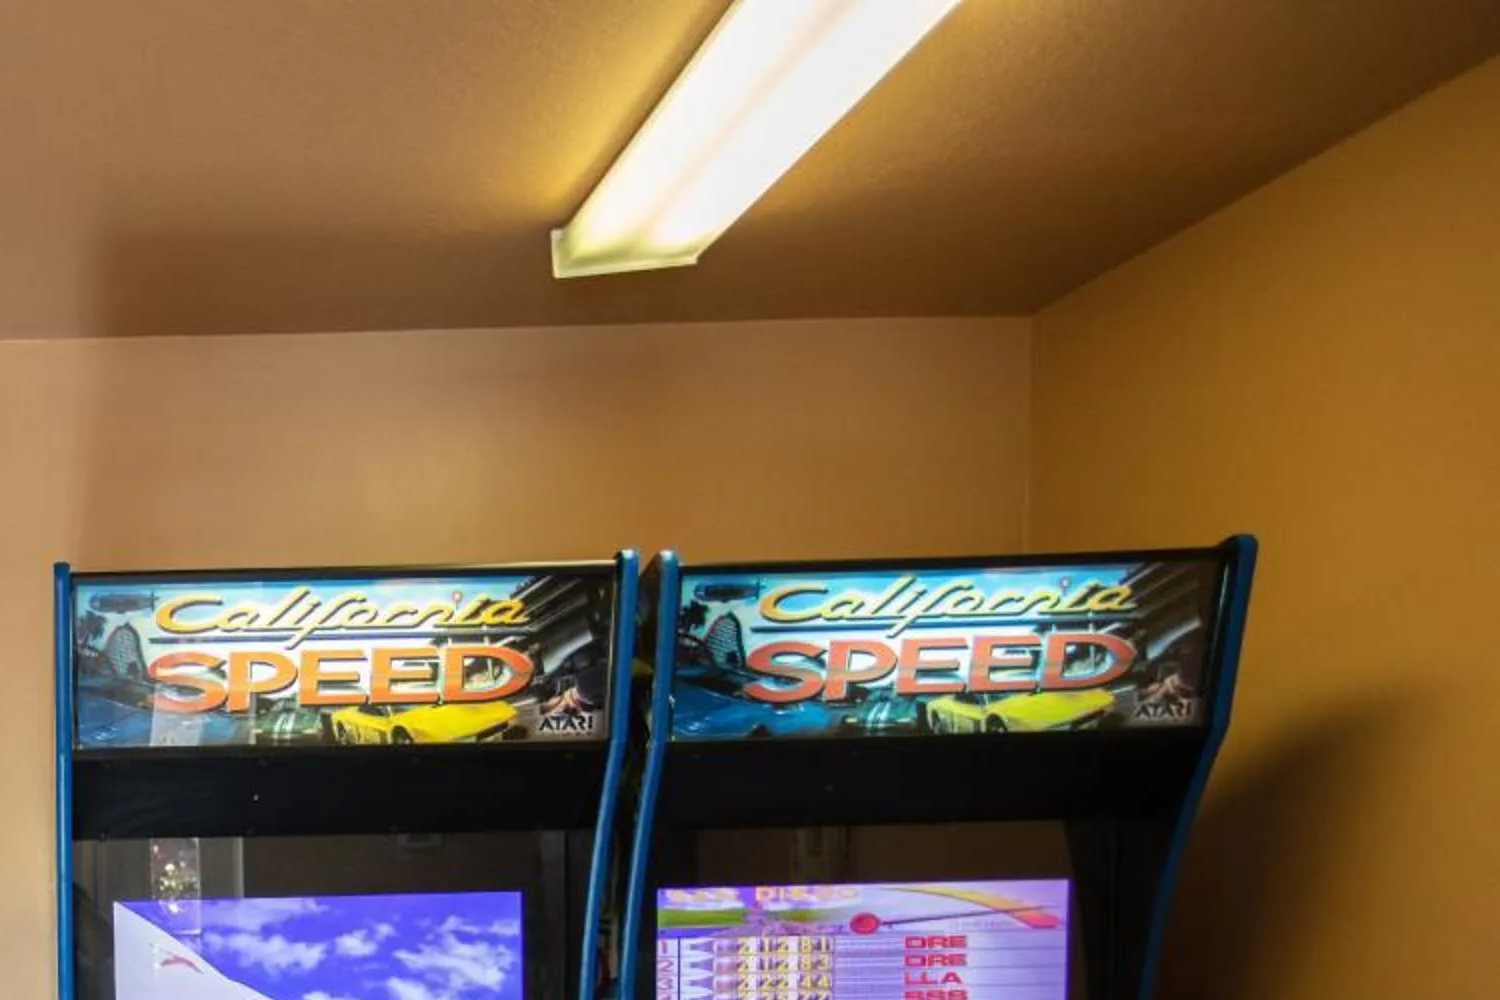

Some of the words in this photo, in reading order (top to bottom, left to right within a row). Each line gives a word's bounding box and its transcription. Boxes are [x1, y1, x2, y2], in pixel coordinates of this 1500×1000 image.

[153, 585, 533, 651] California
[758, 574, 1140, 639] California
[147, 644, 536, 715] SPEED
[743, 632, 1138, 704] SPEED
[539, 714, 594, 731] ATARI
[1135, 701, 1192, 719] ATARI
